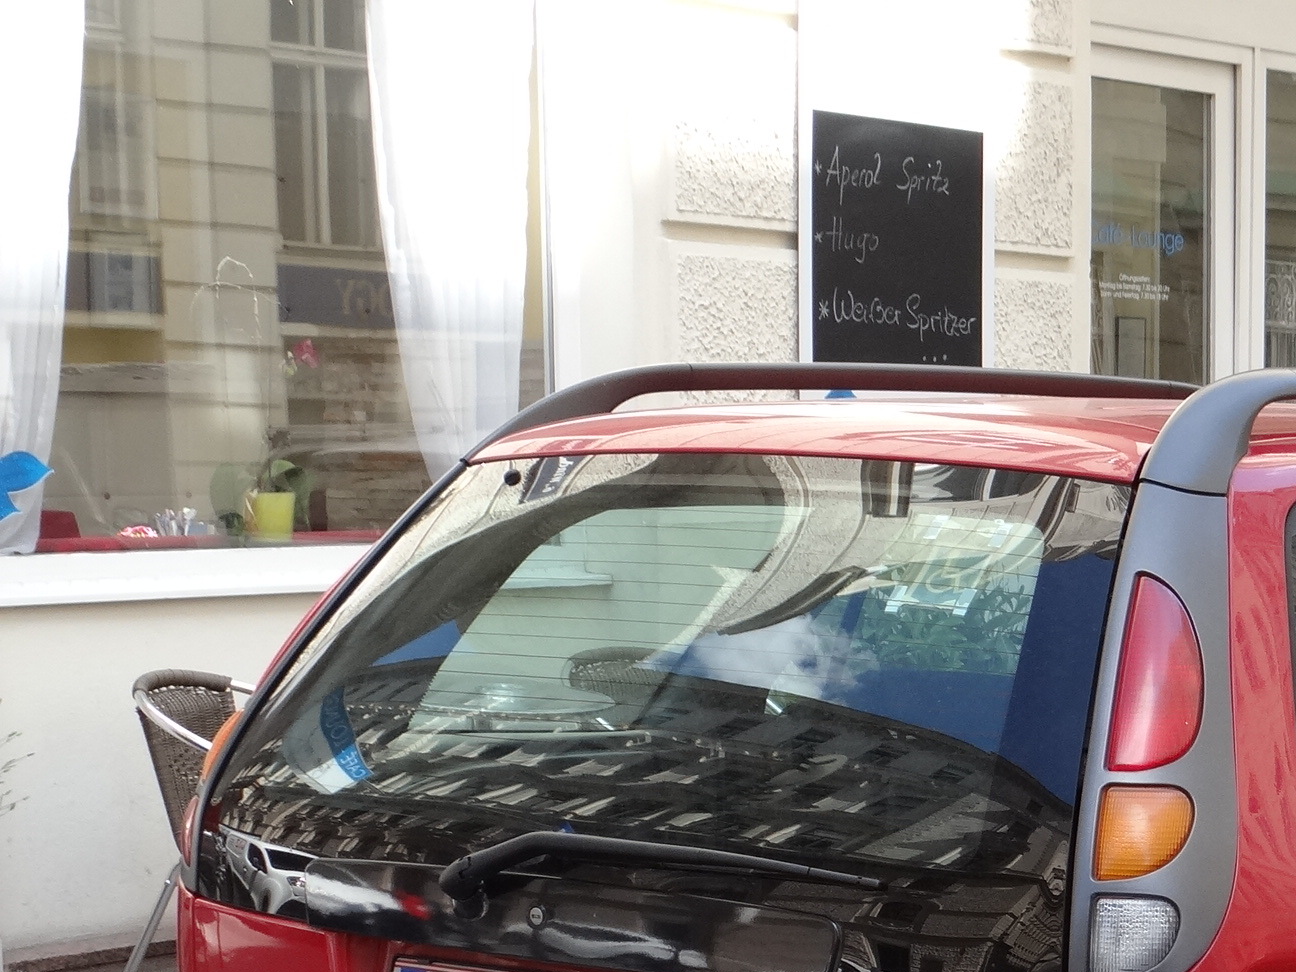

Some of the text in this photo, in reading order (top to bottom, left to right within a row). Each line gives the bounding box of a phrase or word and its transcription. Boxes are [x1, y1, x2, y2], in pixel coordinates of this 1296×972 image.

[825, 145, 949, 205] Aperol Spritz
[825, 216, 880, 264] Hugo
[1131, 225, 1184, 256] Lounge
[906, 293, 977, 342] Spritzer
